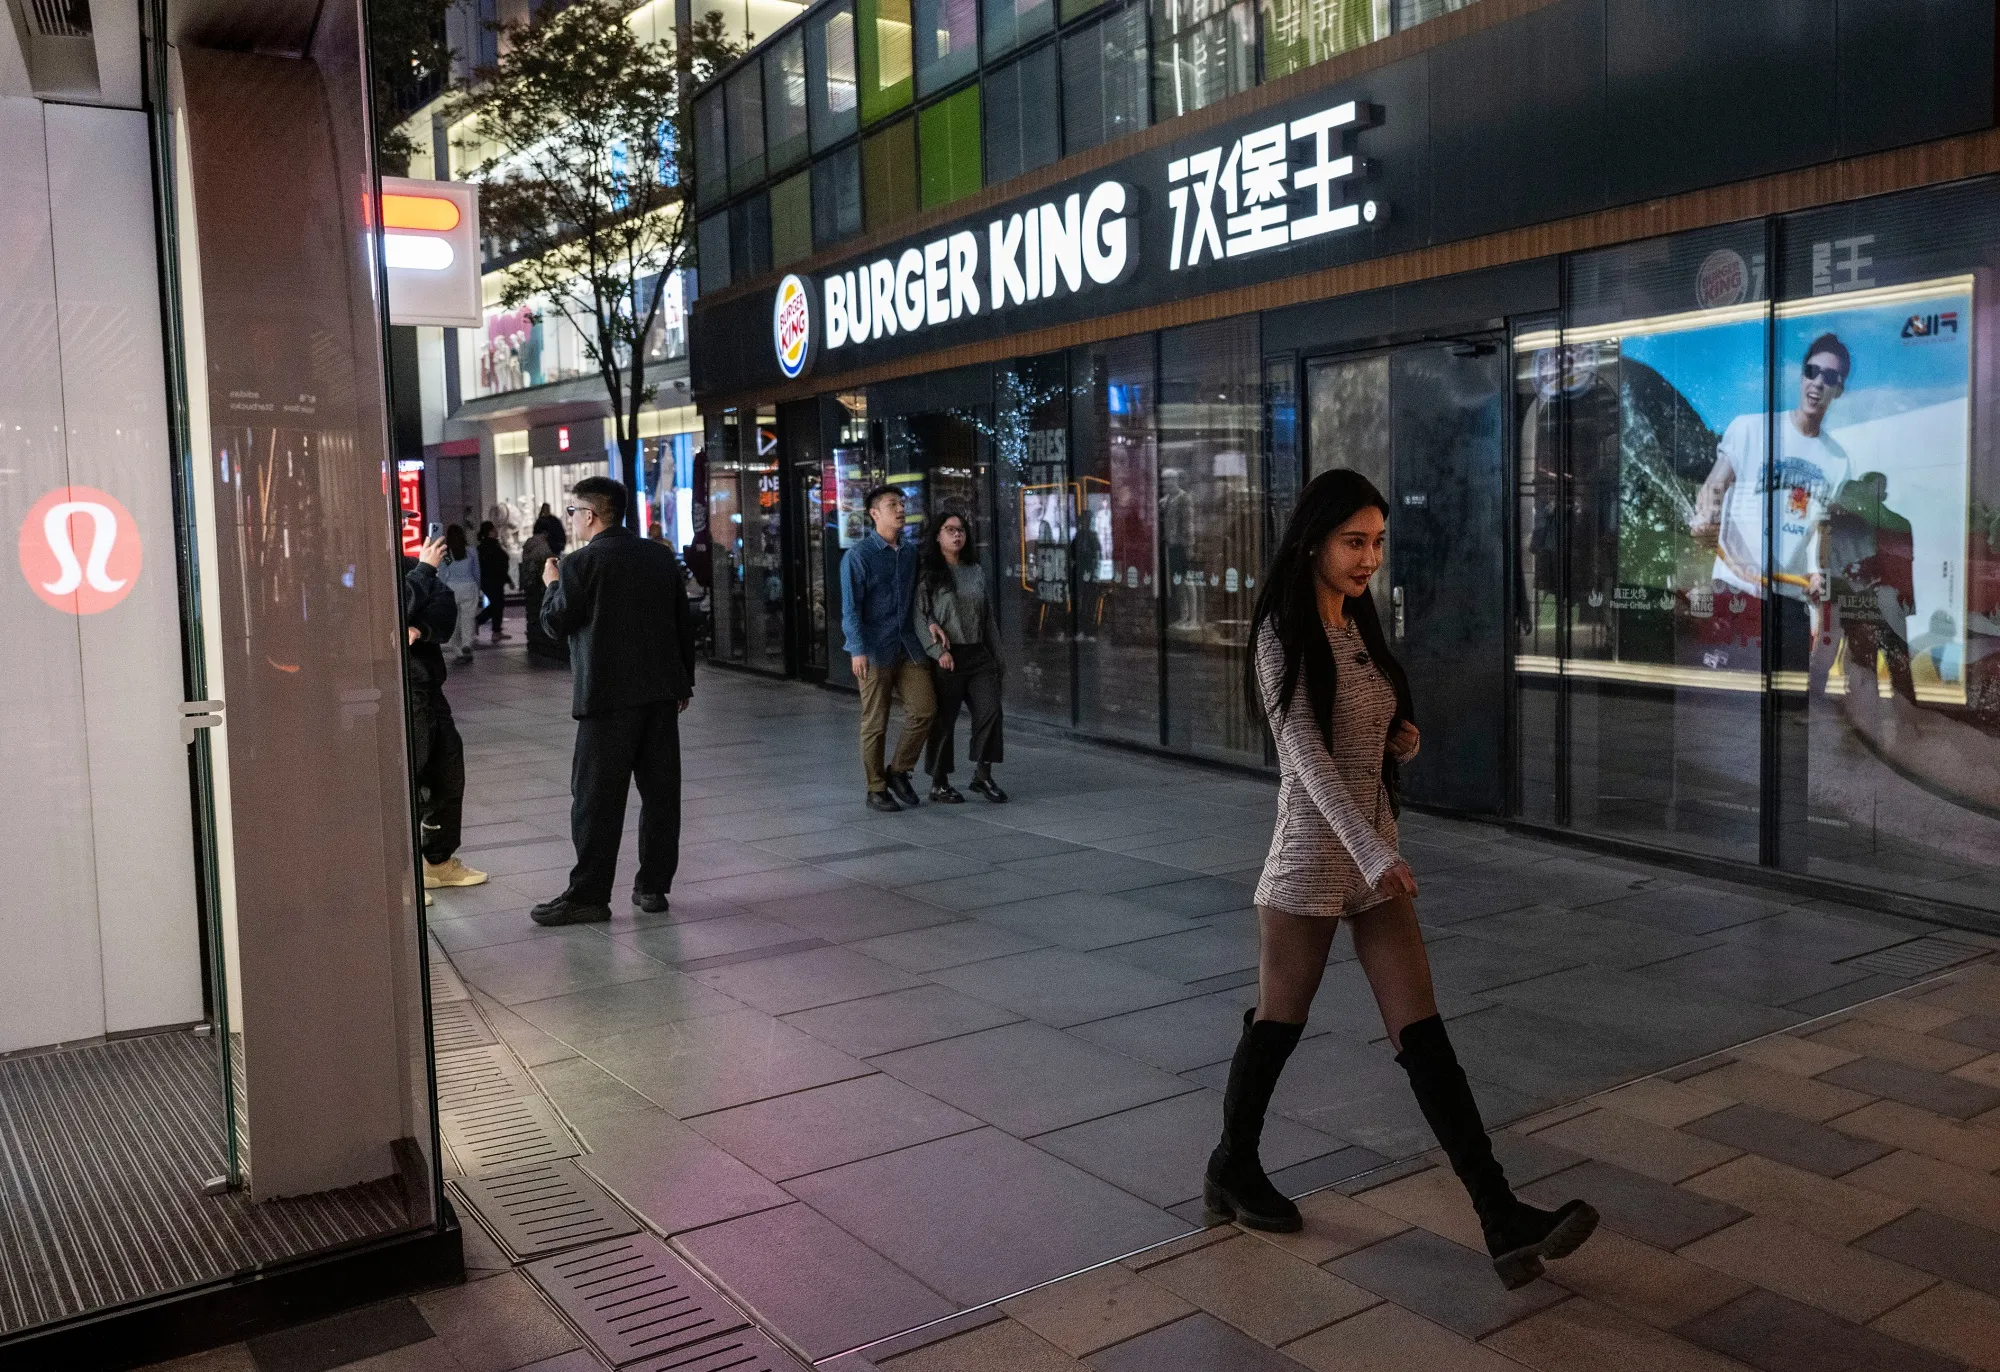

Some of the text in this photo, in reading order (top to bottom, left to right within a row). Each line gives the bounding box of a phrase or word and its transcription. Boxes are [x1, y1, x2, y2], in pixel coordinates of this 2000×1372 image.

[1168, 101, 1359, 271] 汉堡王
[779, 292, 804, 330] BURGER
[825, 181, 1127, 349] BURGER KING
[781, 310, 805, 356] KING
